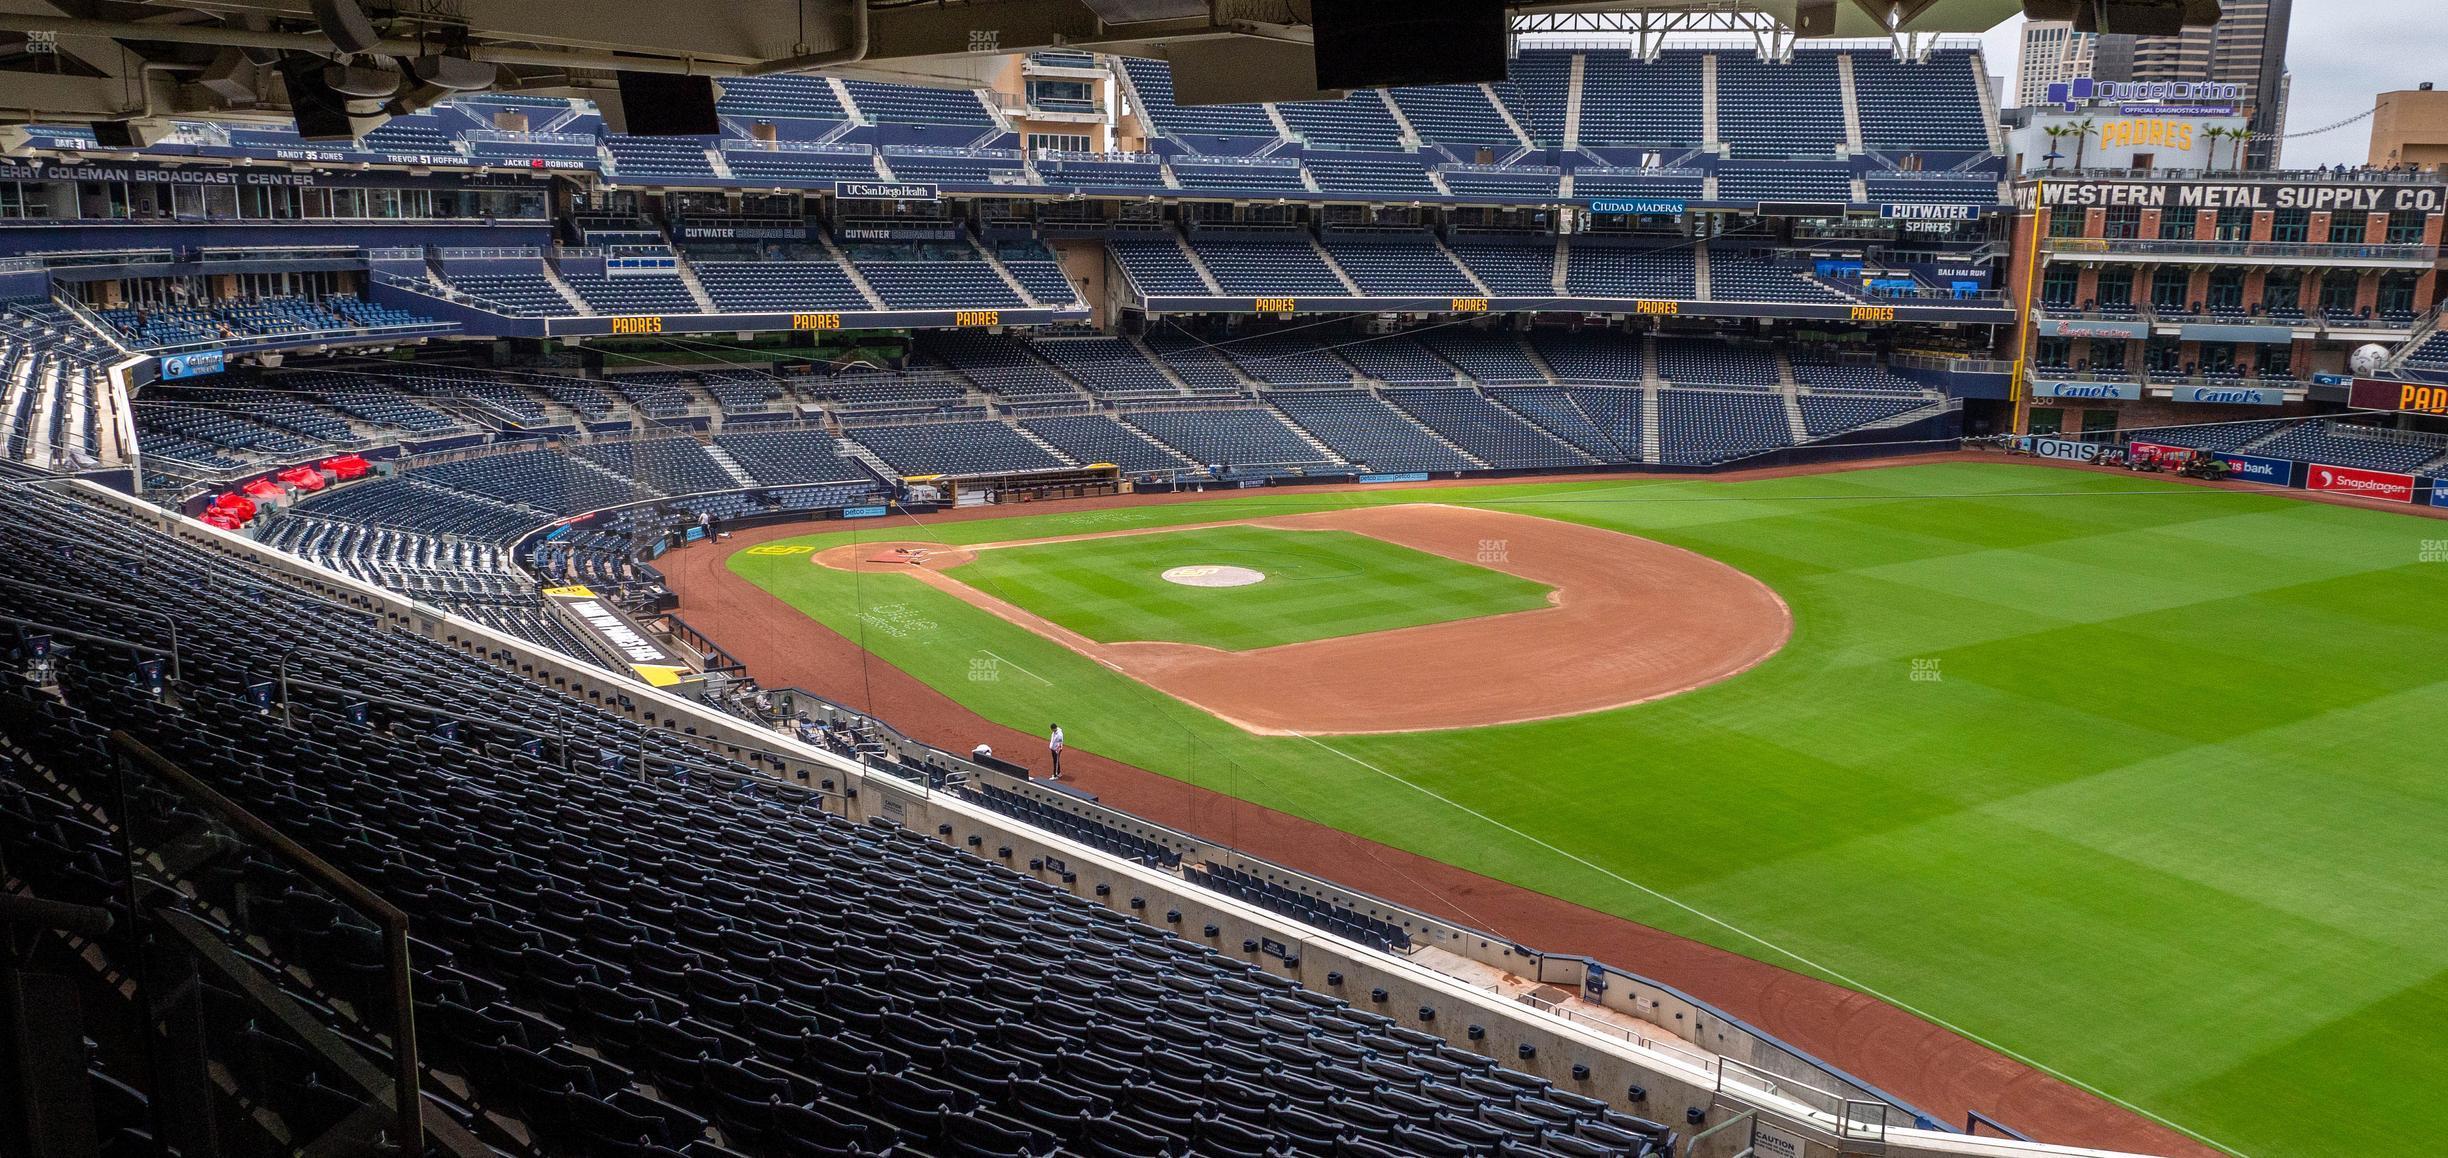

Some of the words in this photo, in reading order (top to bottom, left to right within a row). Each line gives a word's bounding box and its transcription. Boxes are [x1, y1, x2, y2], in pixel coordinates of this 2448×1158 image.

[2098, 80, 2237, 101] QuidelOrtho
[2124, 106, 2154, 114] OFFICIAL
[2100, 119, 2192, 151] PADRES
[277, 150, 304, 158] RANDY
[305, 150, 318, 160] 35
[319, 152, 344, 160] JONES
[387, 154, 418, 163] TREVOR
[420, 155, 431, 164] 51
[432, 156, 469, 165] HOFFMAN
[504, 158, 530, 168] JACKIE
[532, 158, 545, 168] 42
[546, 160, 584, 168] ROBINSON
[48, 166, 128, 181] COLEMAN
[136, 170, 238, 184] BROADCAST
[246, 173, 314, 186] CENTER
[862, 184, 878, 196] San
[878, 186, 901, 198] Diego
[902, 186, 928, 196] Health
[2042, 182, 2166, 206] WESTERN
[2180, 186, 2268, 207] METAL
[2276, 188, 2382, 210] SUPPLY
[2395, 190, 2442, 212] CO.
[1592, 201, 1634, 212] CIUDAD
[1636, 203, 1682, 212] MADERAS
[1892, 206, 1968, 219] CUTWATER
[685, 228, 734, 238] CUTWATER
[846, 230, 890, 238] CUTWATER
[1906, 222, 1952, 234] SPIRITS
[1938, 268, 1955, 276] BALI
[1255, 298, 1294, 312] PADRES
[1452, 298, 1488, 312] PADRES
[1637, 300, 1678, 315] PADRES
[956, 311, 998, 326] PADRES
[1851, 306, 1894, 321] PADRES
[612, 318, 662, 334] PADRES
[793, 314, 840, 330] PADRES
[2054, 382, 2120, 398] Canel's
[2194, 387, 2262, 404] Canel's
[2400, 385, 2448, 413] PAD
[2040, 440, 2096, 460] ORIS
[2244, 462, 2273, 475] bank
[2336, 476, 2406, 494] Snapdragon
[845, 508, 864, 516] petco
[1756, 1131, 1794, 1151] CAUTION
